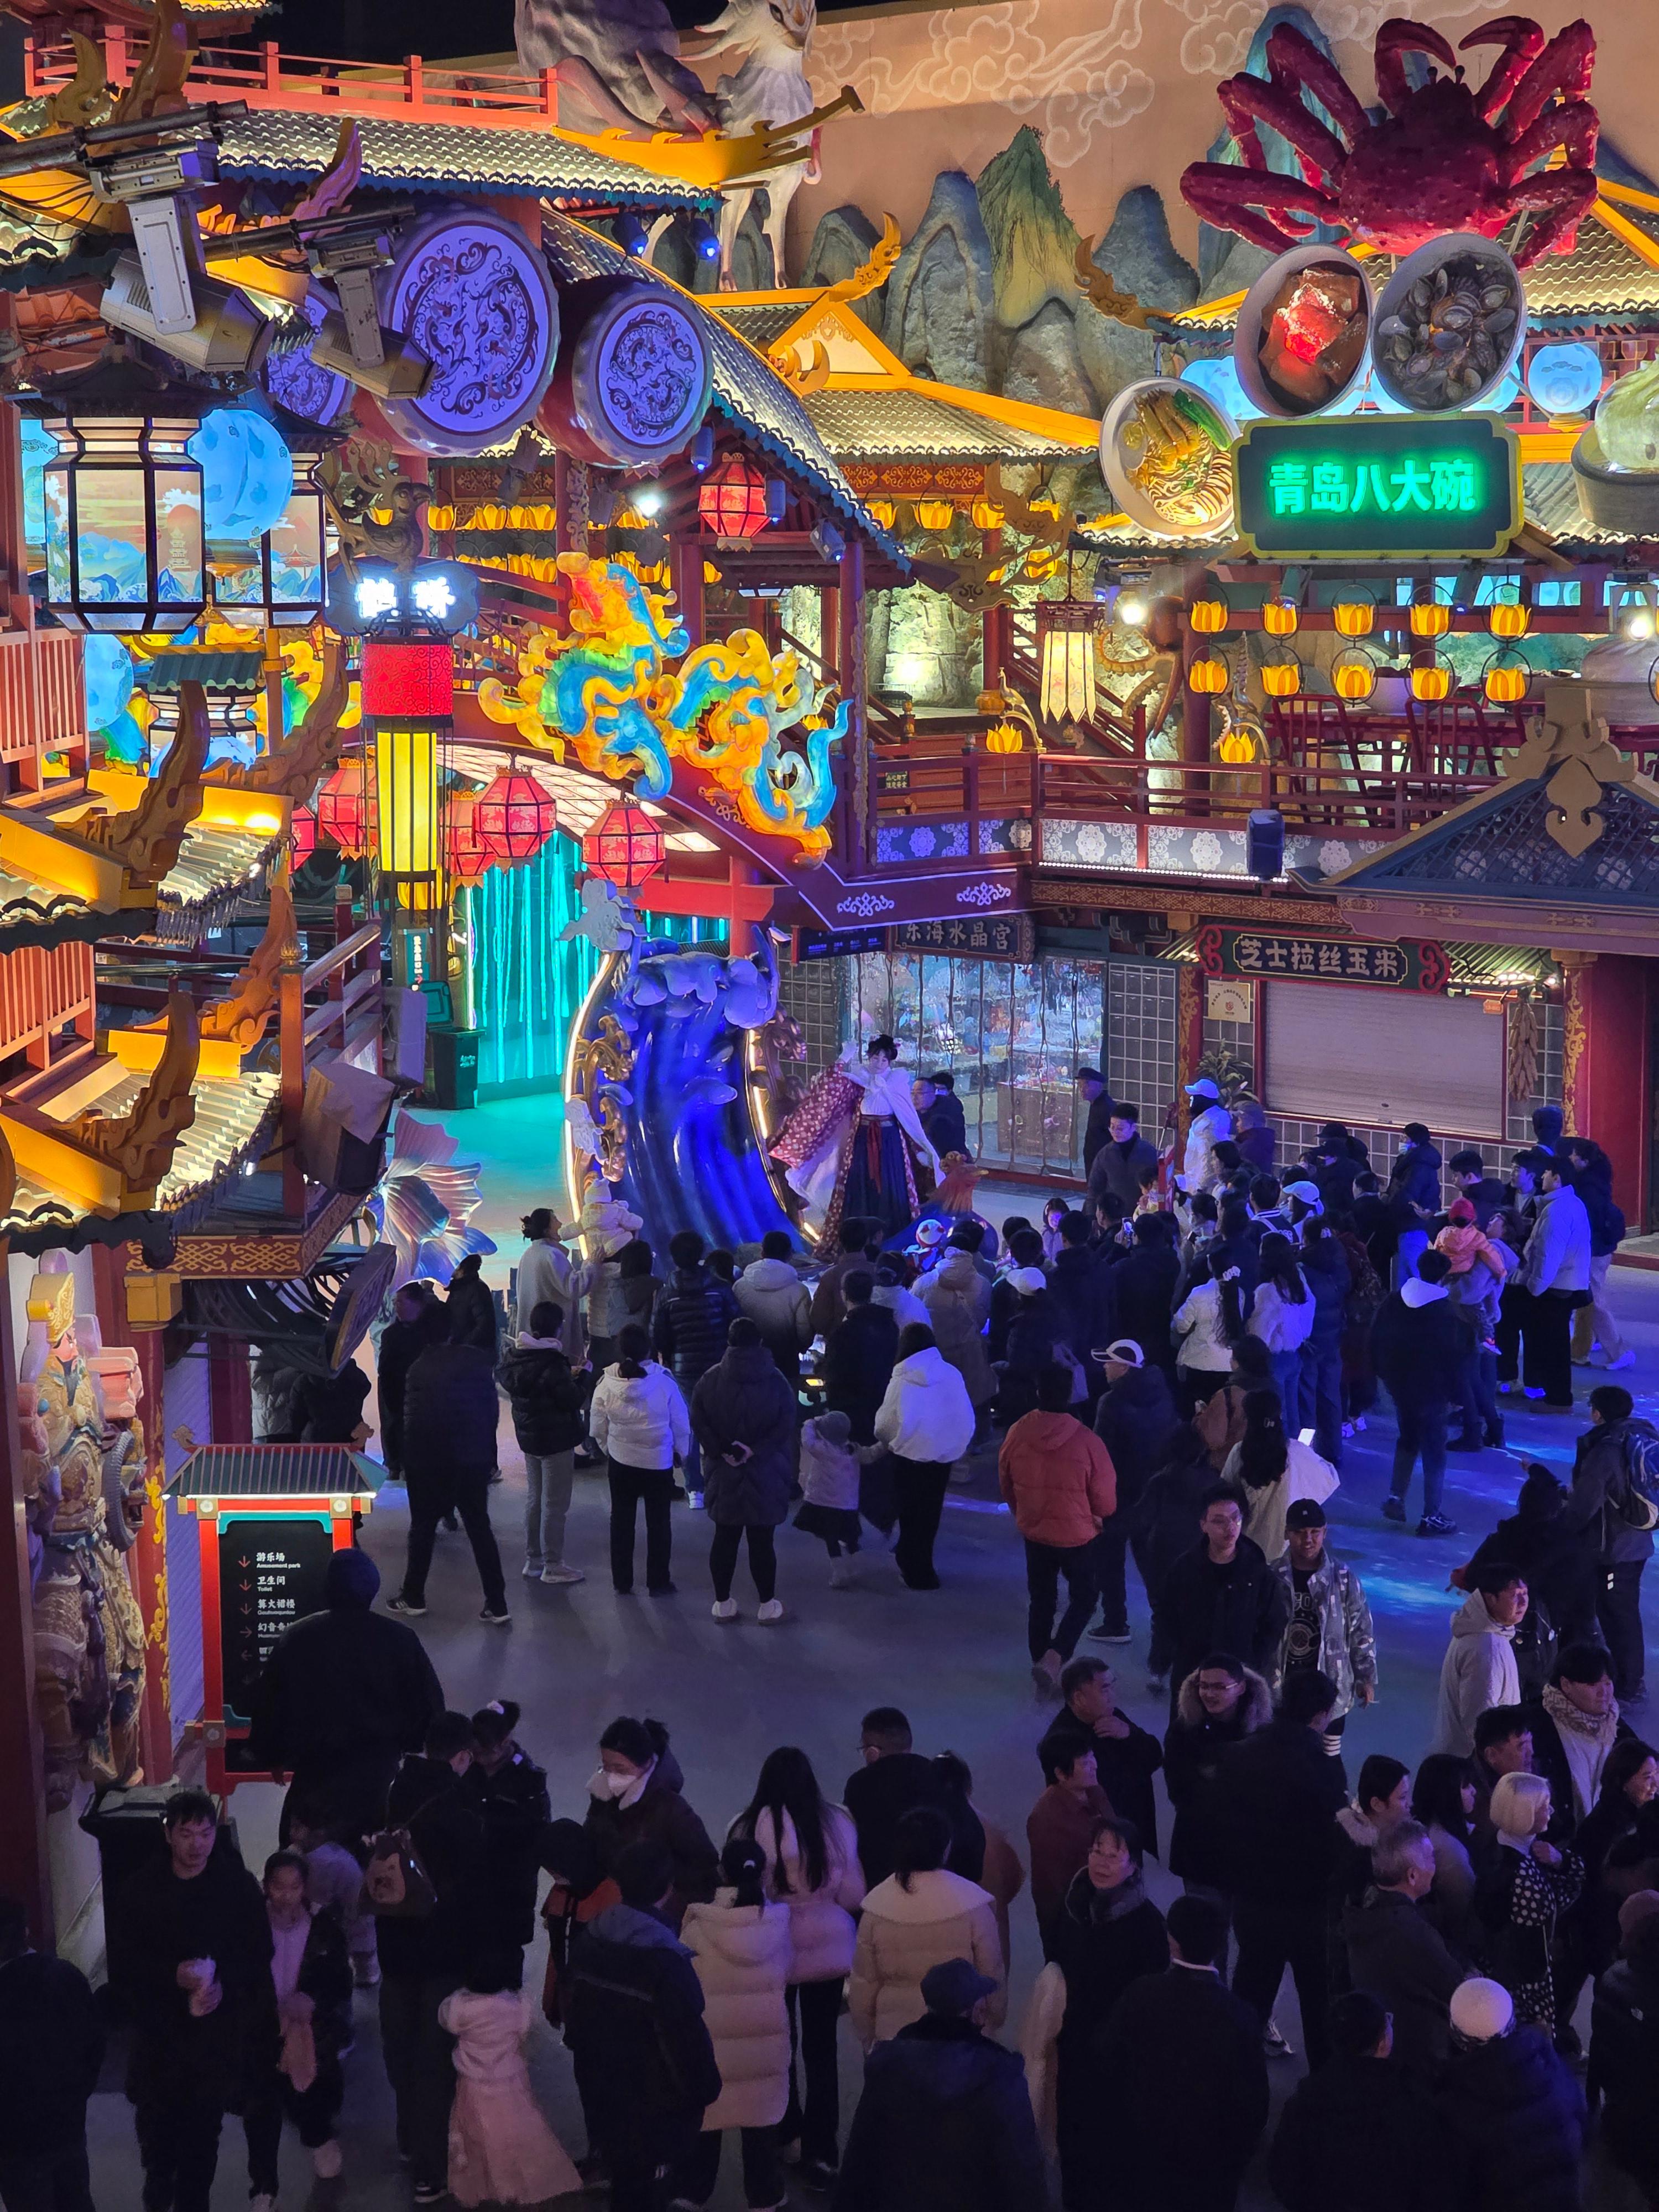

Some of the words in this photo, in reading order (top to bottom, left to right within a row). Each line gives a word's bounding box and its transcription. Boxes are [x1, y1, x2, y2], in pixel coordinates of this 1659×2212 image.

[1269, 458, 1476, 514] 青岛八大碗
[1240, 938, 1398, 978] 芝士拉丝玉米
[256, 1552, 285, 1562] 游乐场
[257, 1575, 285, 1585] 卫生间
